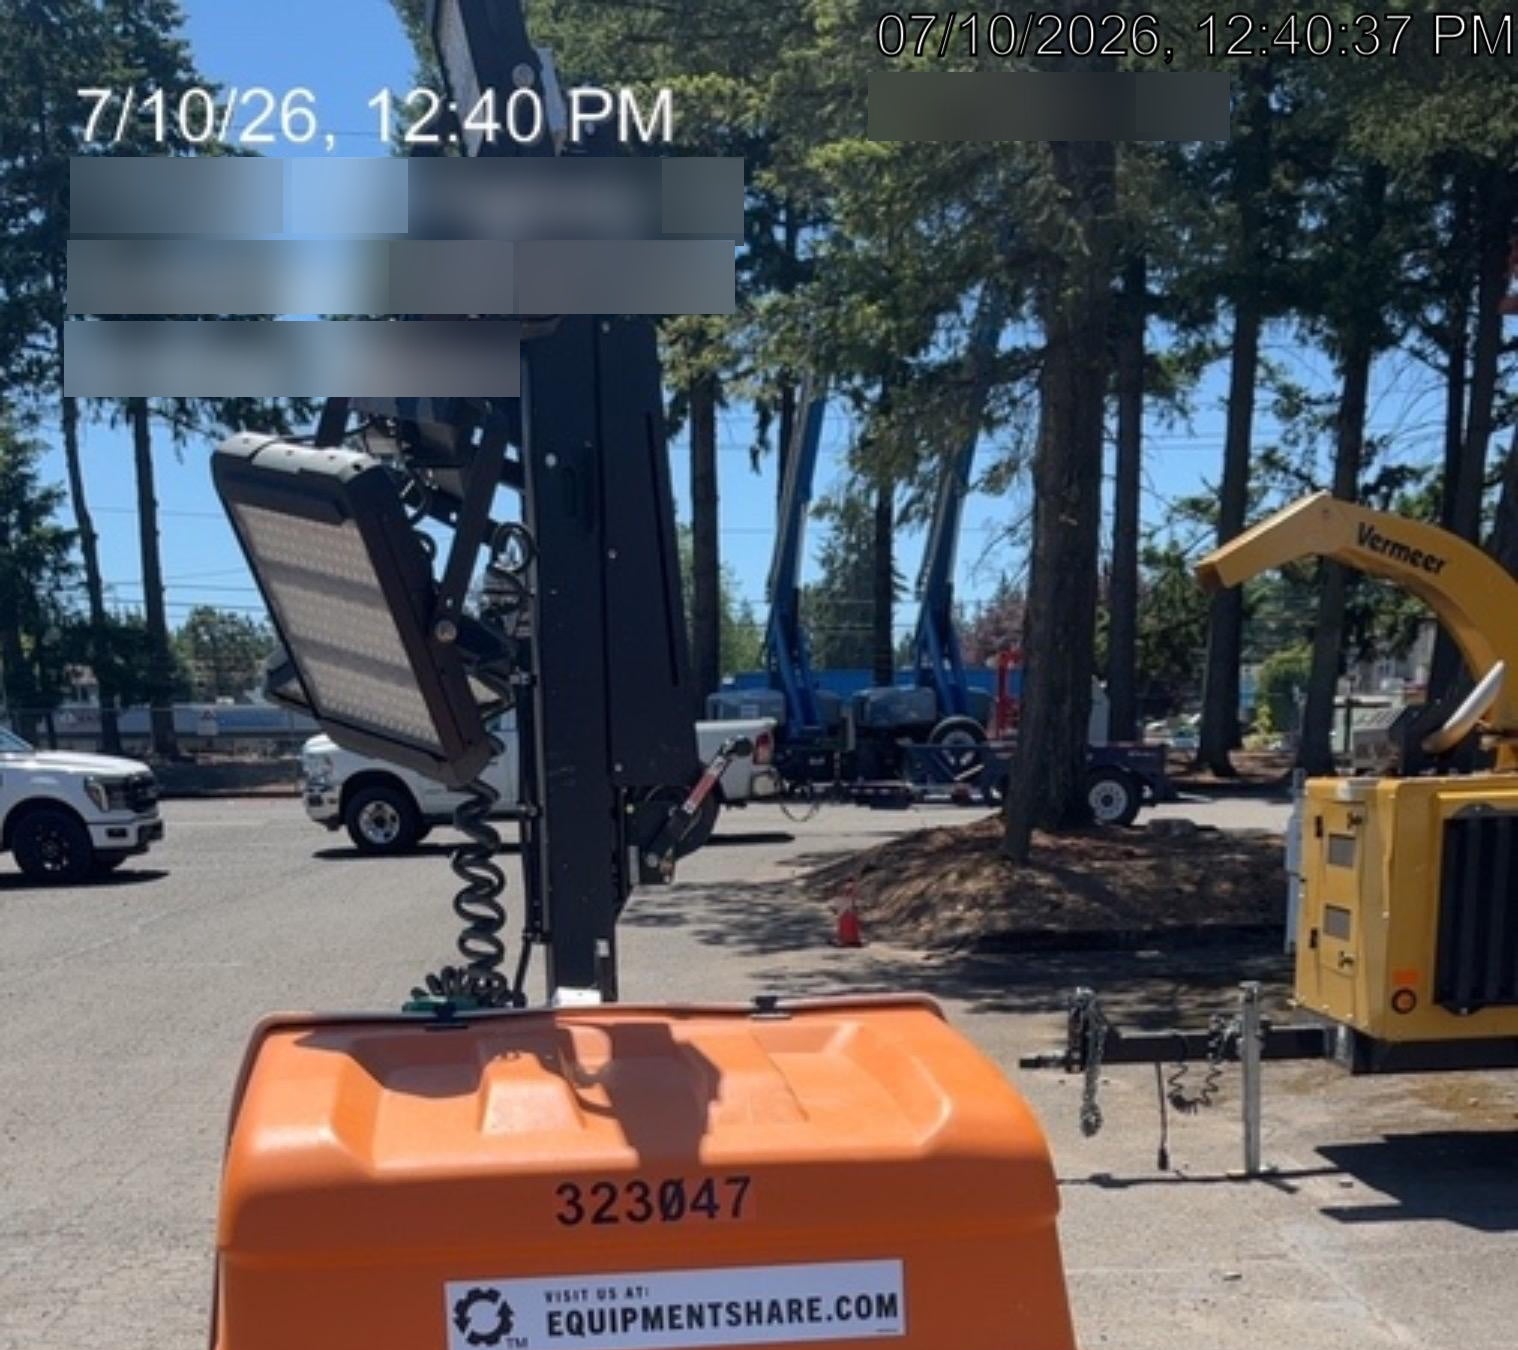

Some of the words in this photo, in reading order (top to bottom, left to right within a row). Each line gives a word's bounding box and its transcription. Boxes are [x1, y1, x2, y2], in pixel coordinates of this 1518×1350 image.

[1358, 521, 1446, 575] Vermeer
[545, 1289, 588, 1303] VISIT
[596, 1287, 616, 1300] US
[626, 1285, 649, 1299] AT:
[547, 1293, 899, 1338] EQUIPMENTSHARE.COM
